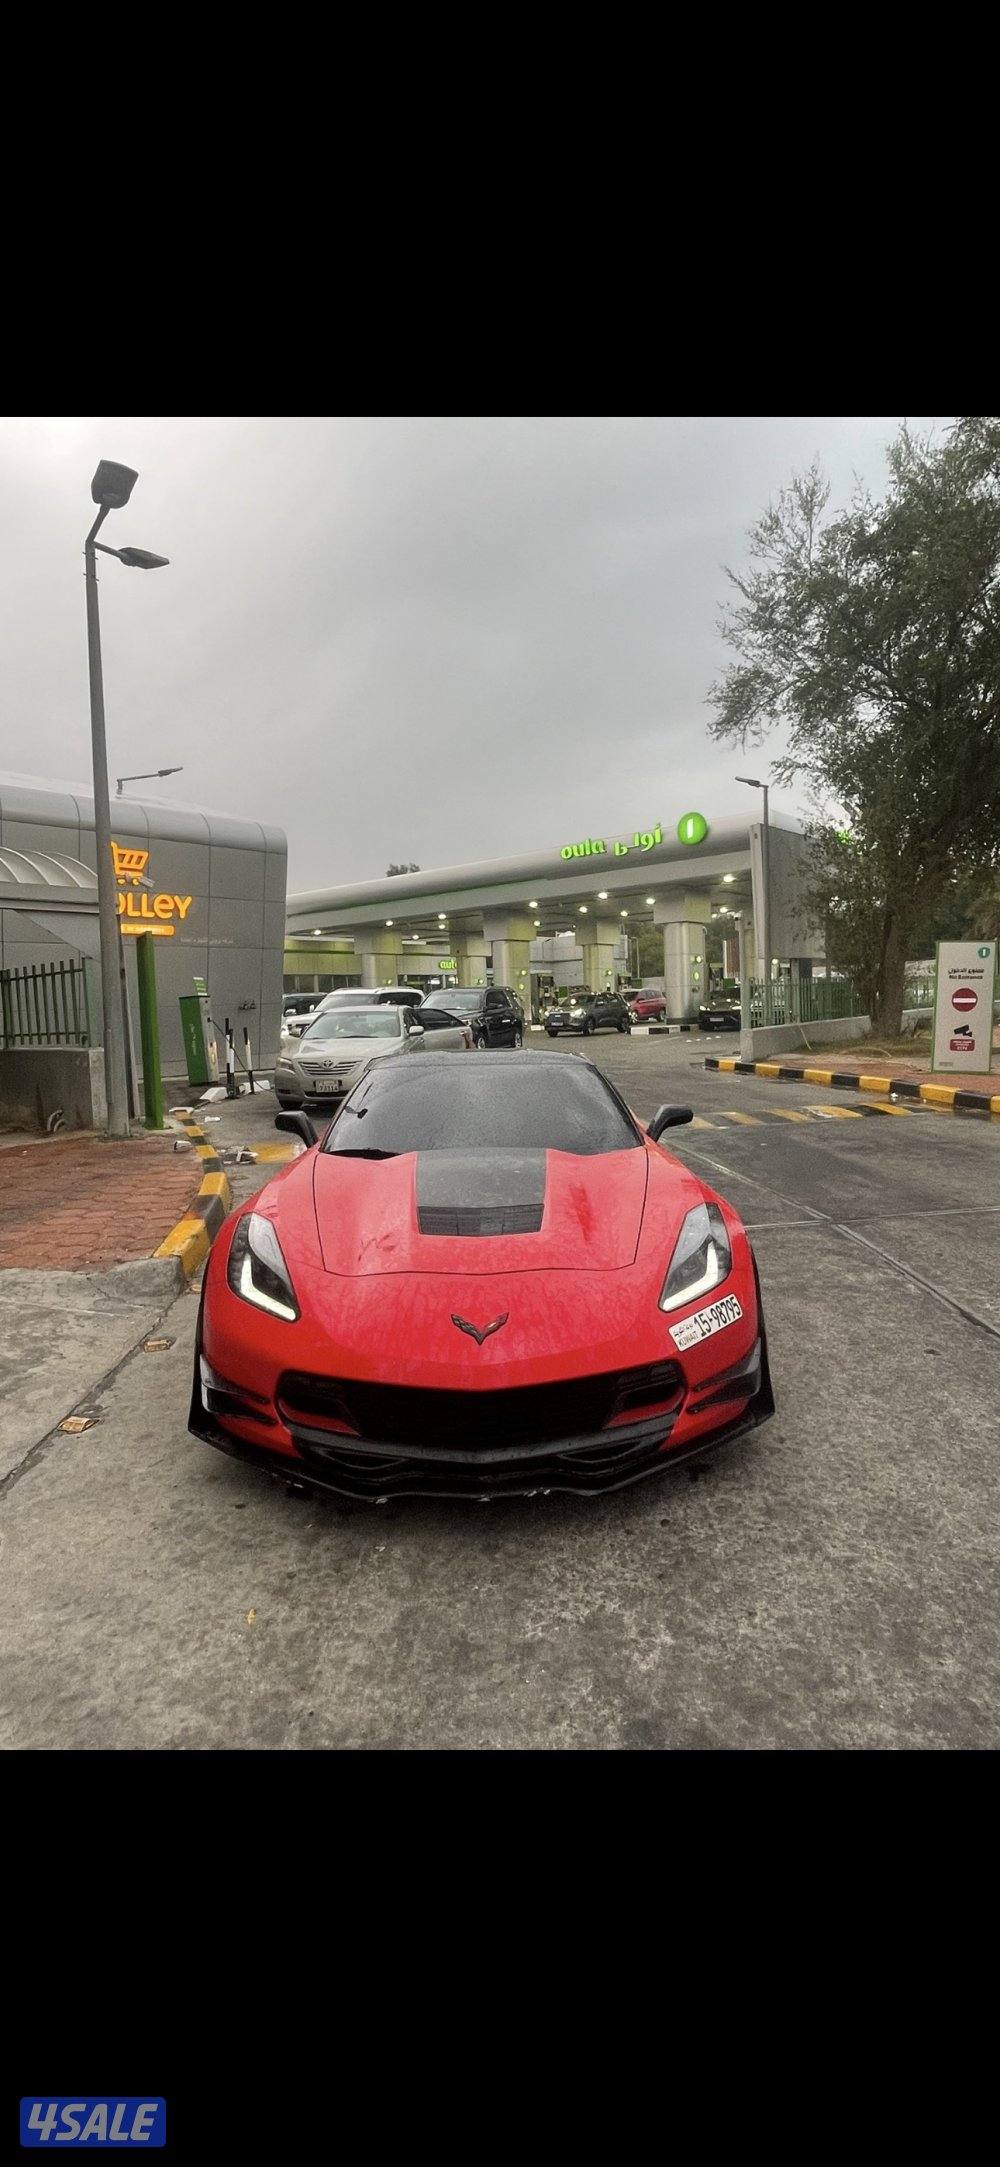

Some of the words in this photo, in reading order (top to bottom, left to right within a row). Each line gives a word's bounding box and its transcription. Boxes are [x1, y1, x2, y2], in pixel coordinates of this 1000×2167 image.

[560, 838, 606, 860] oula
[440, 958, 457, 969] aut
[693, 1296, 741, 1337] 15-98795
[678, 1331, 699, 1347] KUWAIT
